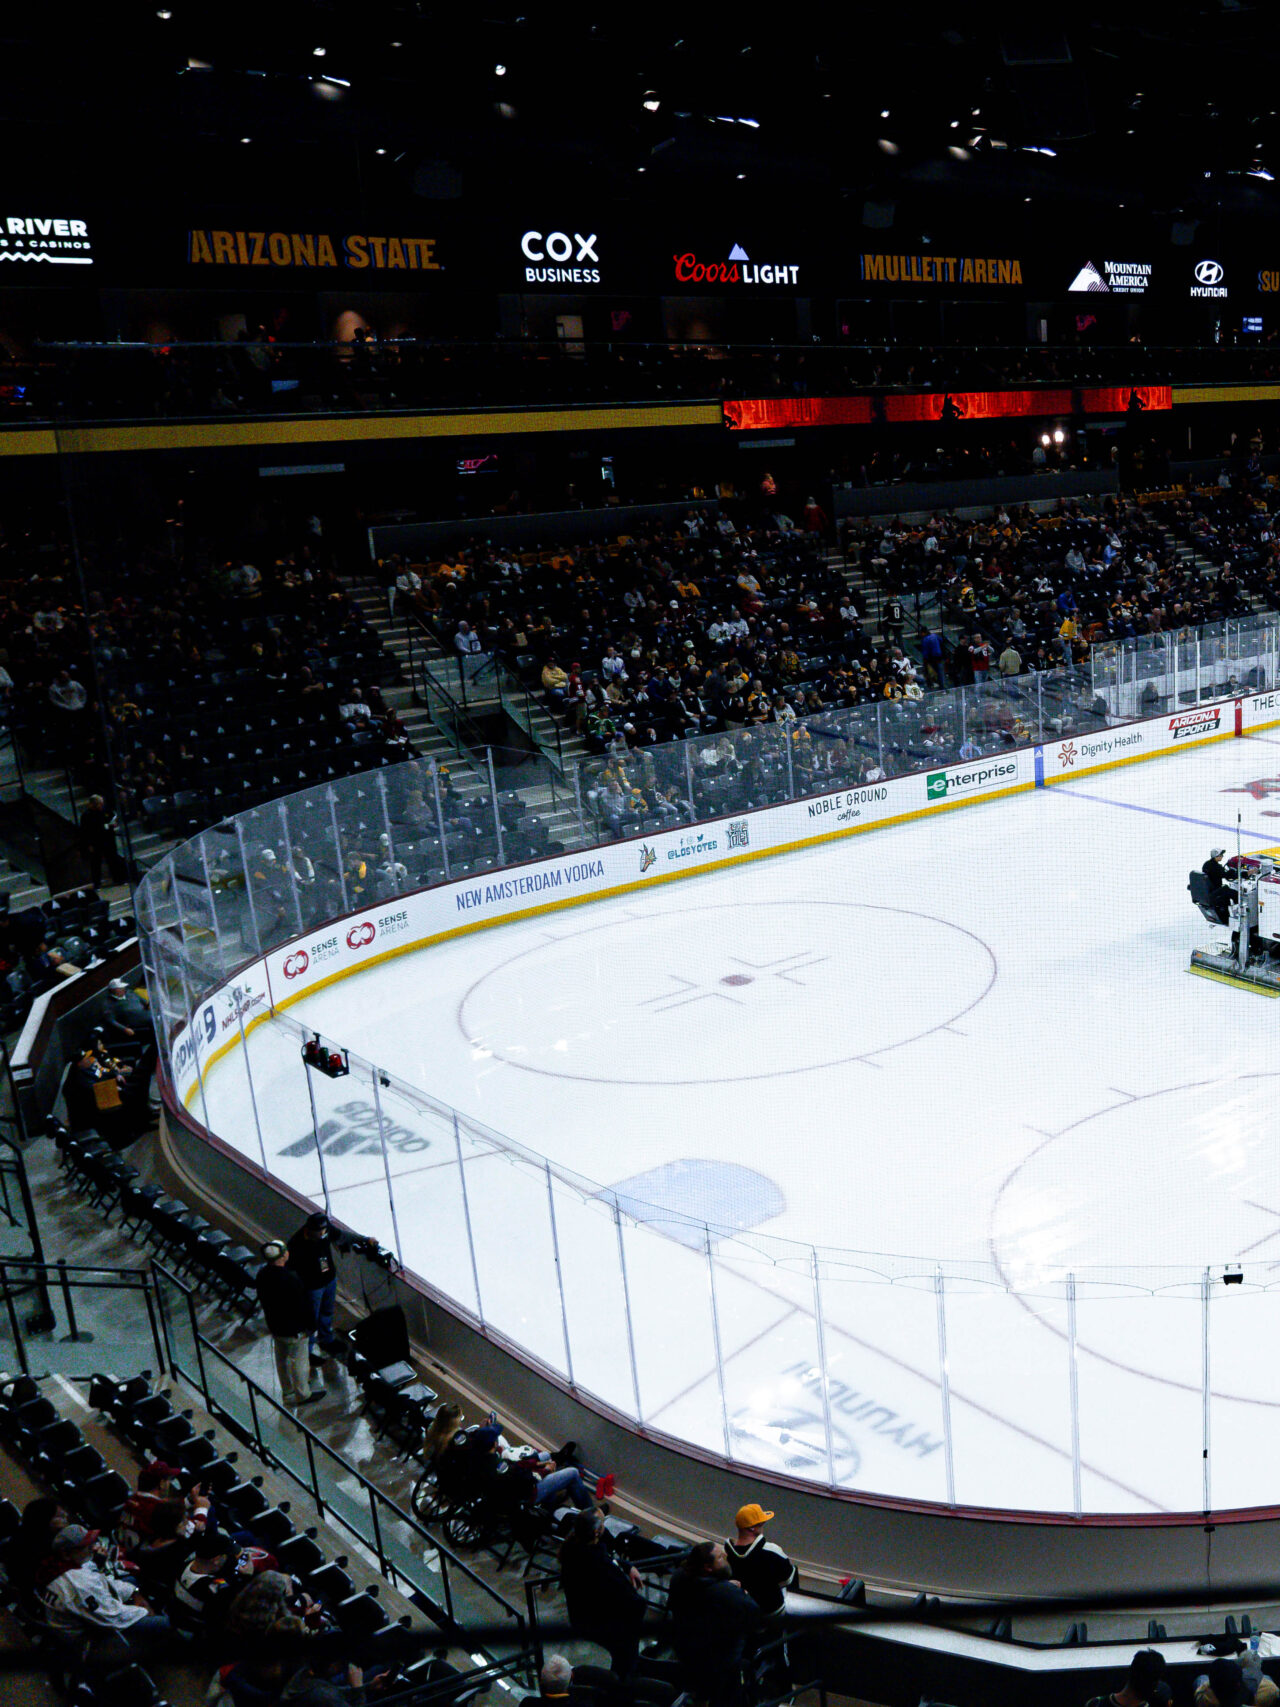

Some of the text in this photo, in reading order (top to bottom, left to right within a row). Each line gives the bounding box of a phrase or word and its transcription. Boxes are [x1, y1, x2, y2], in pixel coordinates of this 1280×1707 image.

[6, 217, 88, 236] RIVER
[29, 240, 91, 249] CASINOS
[188, 230, 338, 266] ARIZONA
[521, 231, 599, 262] COX
[525, 268, 600, 283] BUSINESS
[673, 253, 799, 284] Coors LIGHT
[861, 254, 1023, 284] MULLETT ARENA
[1104, 261, 1151, 275] MOUNTAIN
[1108, 274, 1148, 287] AMERICA
[1190, 287, 1227, 297] HYUNDAI
[1171, 710, 1216, 729] ARIZONA
[1176, 720, 1218, 738] SPORTS
[1081, 732, 1143, 757] Dignity Health
[930, 763, 1016, 792] enterprise
[807, 787, 888, 818] NOBLE GROUND
[837, 809, 861, 821] coffee
[667, 840, 718, 860] @LOSYOTES
[456, 860, 605, 911] NEW AMSTERDAM VODKA
[378, 910, 408, 928] SENSE
[380, 920, 410, 937] ARENA
[311, 937, 338, 955] SENSE
[313, 947, 340, 964] ARENA
